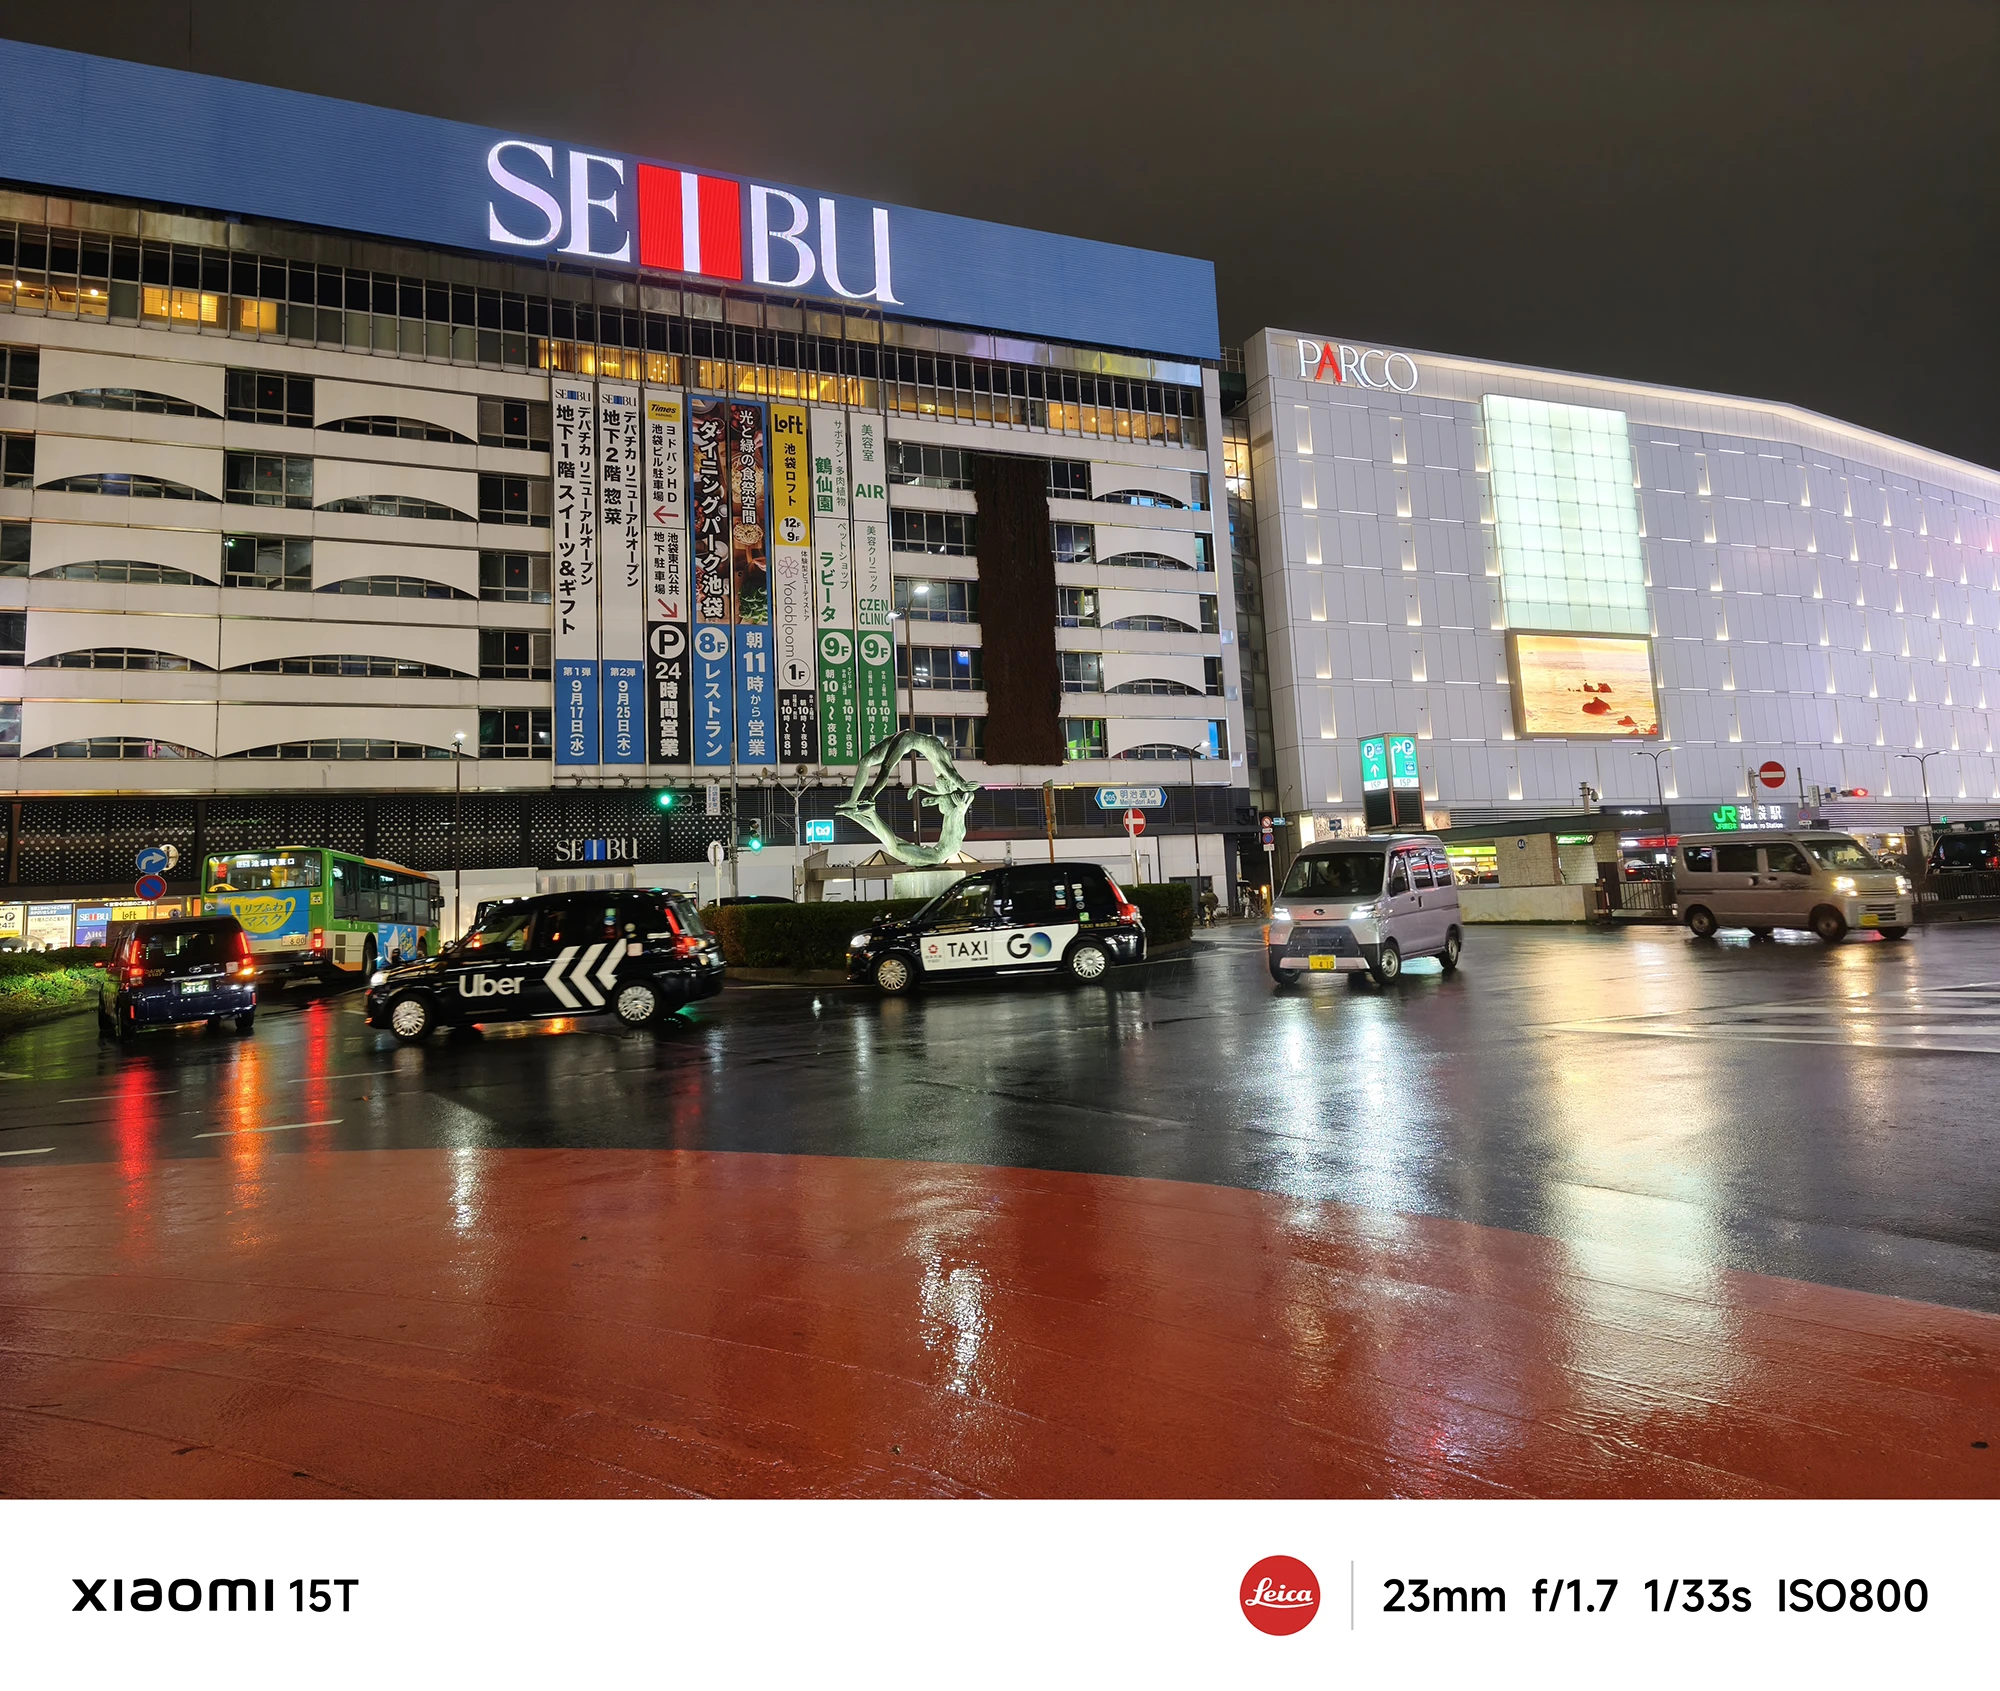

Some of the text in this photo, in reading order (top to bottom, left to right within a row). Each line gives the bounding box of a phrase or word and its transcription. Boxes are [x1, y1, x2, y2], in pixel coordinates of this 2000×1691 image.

[487, 140, 904, 305] SEIBU
[1297, 338, 1418, 392] PARCO
[555, 389, 591, 402] SEIBU
[601, 393, 637, 407] SEIBU
[651, 404, 677, 414] Times
[861, 424, 875, 462] 美容室
[602, 409, 622, 525] 地下2階 惣菜
[652, 423, 664, 502] 池袋ビル駐車場
[666, 426, 677, 503] ヨドバシHD
[740, 410, 756, 524] 光と緑の食祭空間
[784, 443, 797, 506] 池袋ロフト
[578, 406, 594, 585] デパチカ リニューアルオープン
[624, 411, 639, 587] デパチカ リニューアルオープン
[815, 456, 833, 513] 鶴仙園
[855, 484, 885, 499] AIR
[556, 404, 577, 635] 地下1階 スイーツ&ギフト
[699, 421, 723, 618] ダイニングパーク池袋
[653, 531, 665, 595] 地下駐車場
[667, 532, 679, 595] 池袋東口公共
[867, 526, 878, 592] 美容クリニック
[820, 552, 836, 622] ラビータ
[859, 599, 889, 612] CZEN
[699, 632, 726, 653] 8F
[824, 637, 849, 657] 9F
[864, 639, 889, 659] 9F
[563, 667, 592, 677] 第1弾
[610, 668, 636, 677] 第2弾
[788, 664, 806, 680] 1F
[655, 662, 682, 757] 24時間営業
[704, 663, 723, 758] レストラン
[743, 631, 766, 757] 朝11時から営業
[1119, 789, 1156, 799] 明治通り
[1713, 805, 1737, 823] JR
[554, 837, 639, 861] SEIBU
[80, 912, 109, 921] SEIBU
[244, 914, 282, 927] マスク
[947, 940, 988, 957] TAXI
[1007, 932, 1053, 959] GO
[459, 973, 525, 998] Uber
